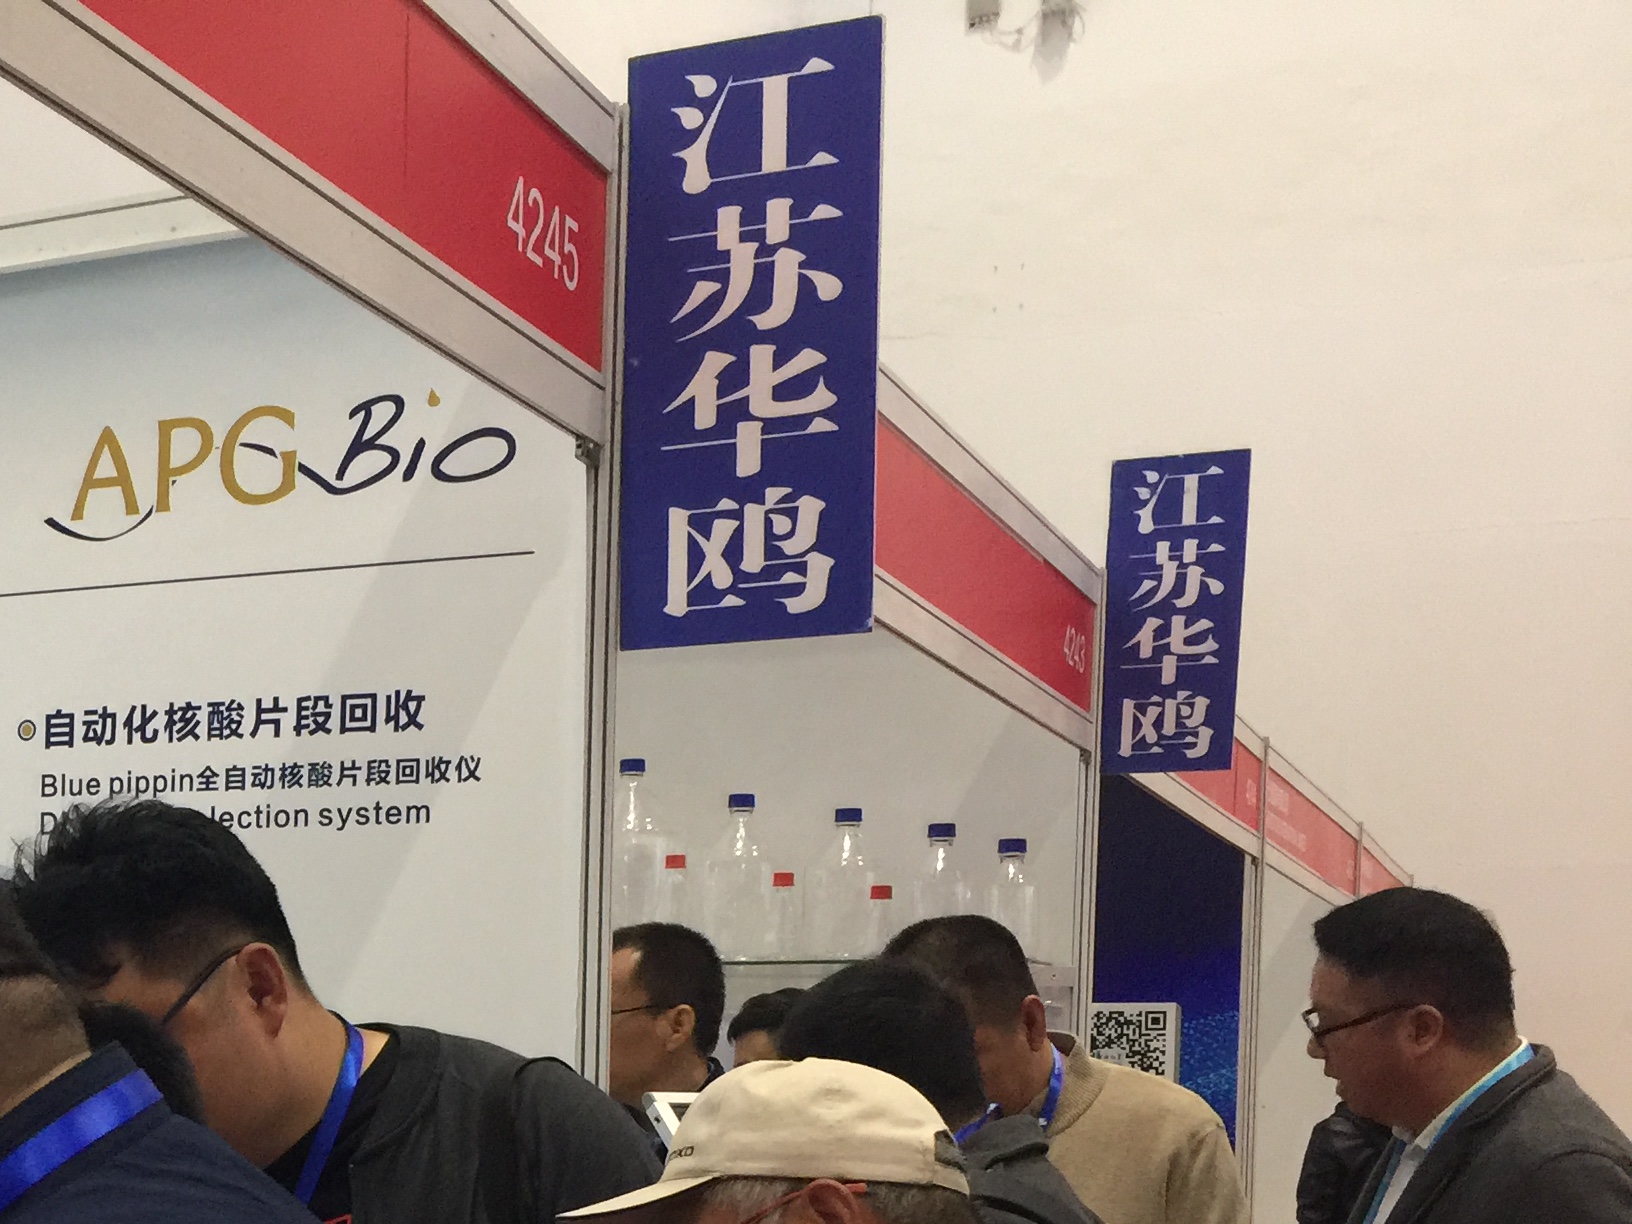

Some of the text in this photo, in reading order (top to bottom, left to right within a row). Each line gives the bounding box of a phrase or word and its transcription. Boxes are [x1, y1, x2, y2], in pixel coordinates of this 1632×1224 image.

[507, 175, 579, 291] 4245
[661, 57, 843, 618] 江苏华鸥
[1118, 465, 1226, 758] 江苏华鸥
[1064, 625, 1085, 673] 4243
[44, 690, 425, 749] 自动化核酸片段回收
[41, 773, 101, 798] Blue
[210, 800, 431, 831] lection system
